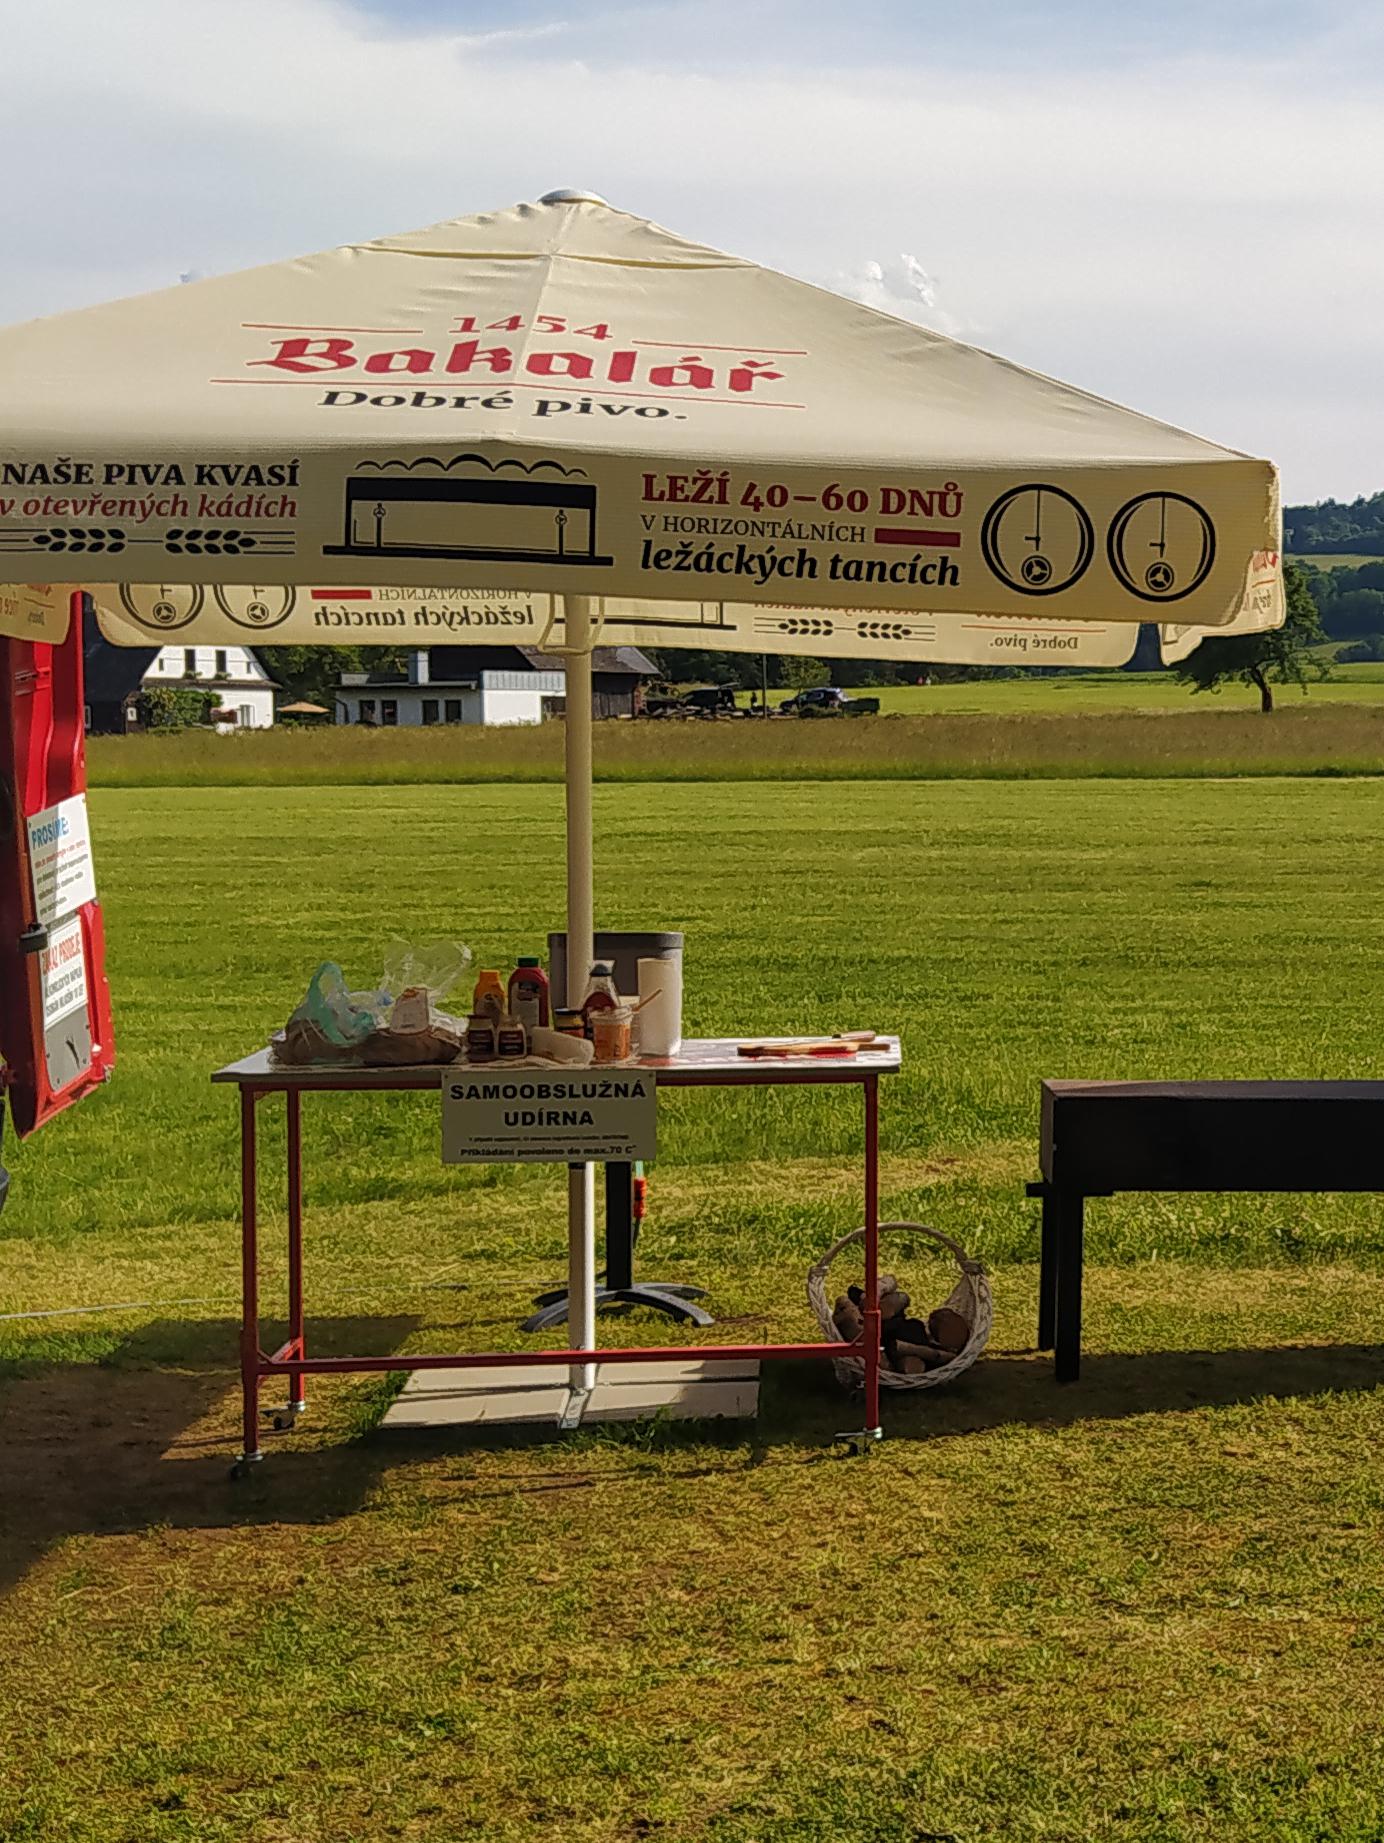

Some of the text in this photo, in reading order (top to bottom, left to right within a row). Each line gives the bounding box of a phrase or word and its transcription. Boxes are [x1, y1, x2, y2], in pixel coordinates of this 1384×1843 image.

[450, 315, 614, 341] 1454
[246, 337, 786, 392] Bakalář
[316, 389, 689, 421] Dobré pivo.
[2, 457, 300, 487] NAŠE PIVA KVASÍ
[22, 493, 189, 524] otevřených
[198, 493, 297, 519] kádích
[641, 469, 730, 505] LEŽÍ
[879, 482, 964, 518] DNŮ
[641, 514, 866, 543] V HORIZONTÁLNÍCH
[640, 539, 961, 587] ležáckých tancích
[449, 1080, 647, 1100] SAMOOBSLUŽNÁ
[504, 1108, 595, 1126] UDÍRNA
